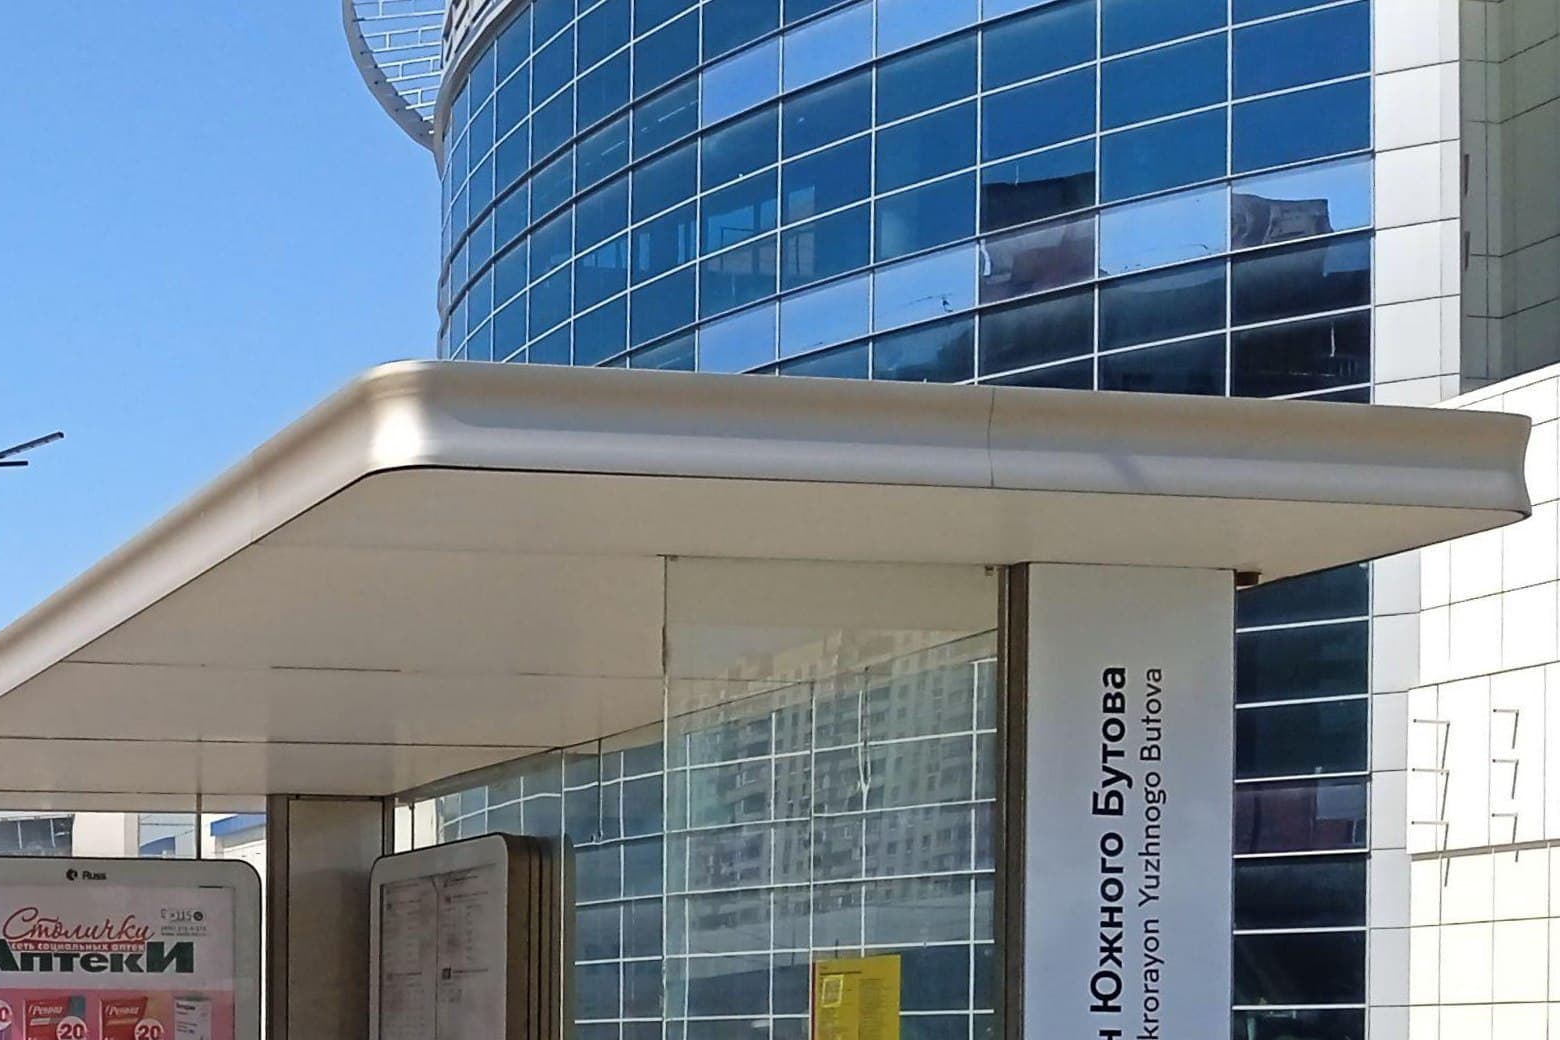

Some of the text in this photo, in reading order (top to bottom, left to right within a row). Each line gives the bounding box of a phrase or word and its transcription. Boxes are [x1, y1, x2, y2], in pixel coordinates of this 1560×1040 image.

[1092, 666, 1133, 816] Бутова
[1140, 667, 1163, 761] Butova
[82, 871, 107, 881] Russ
[1138, 771, 1167, 907] Yuzhnogo
[2, 906, 155, 941] Столички
[11, 942, 145, 952] сеть социальных аптек
[1090, 832, 1125, 1013] Южного
